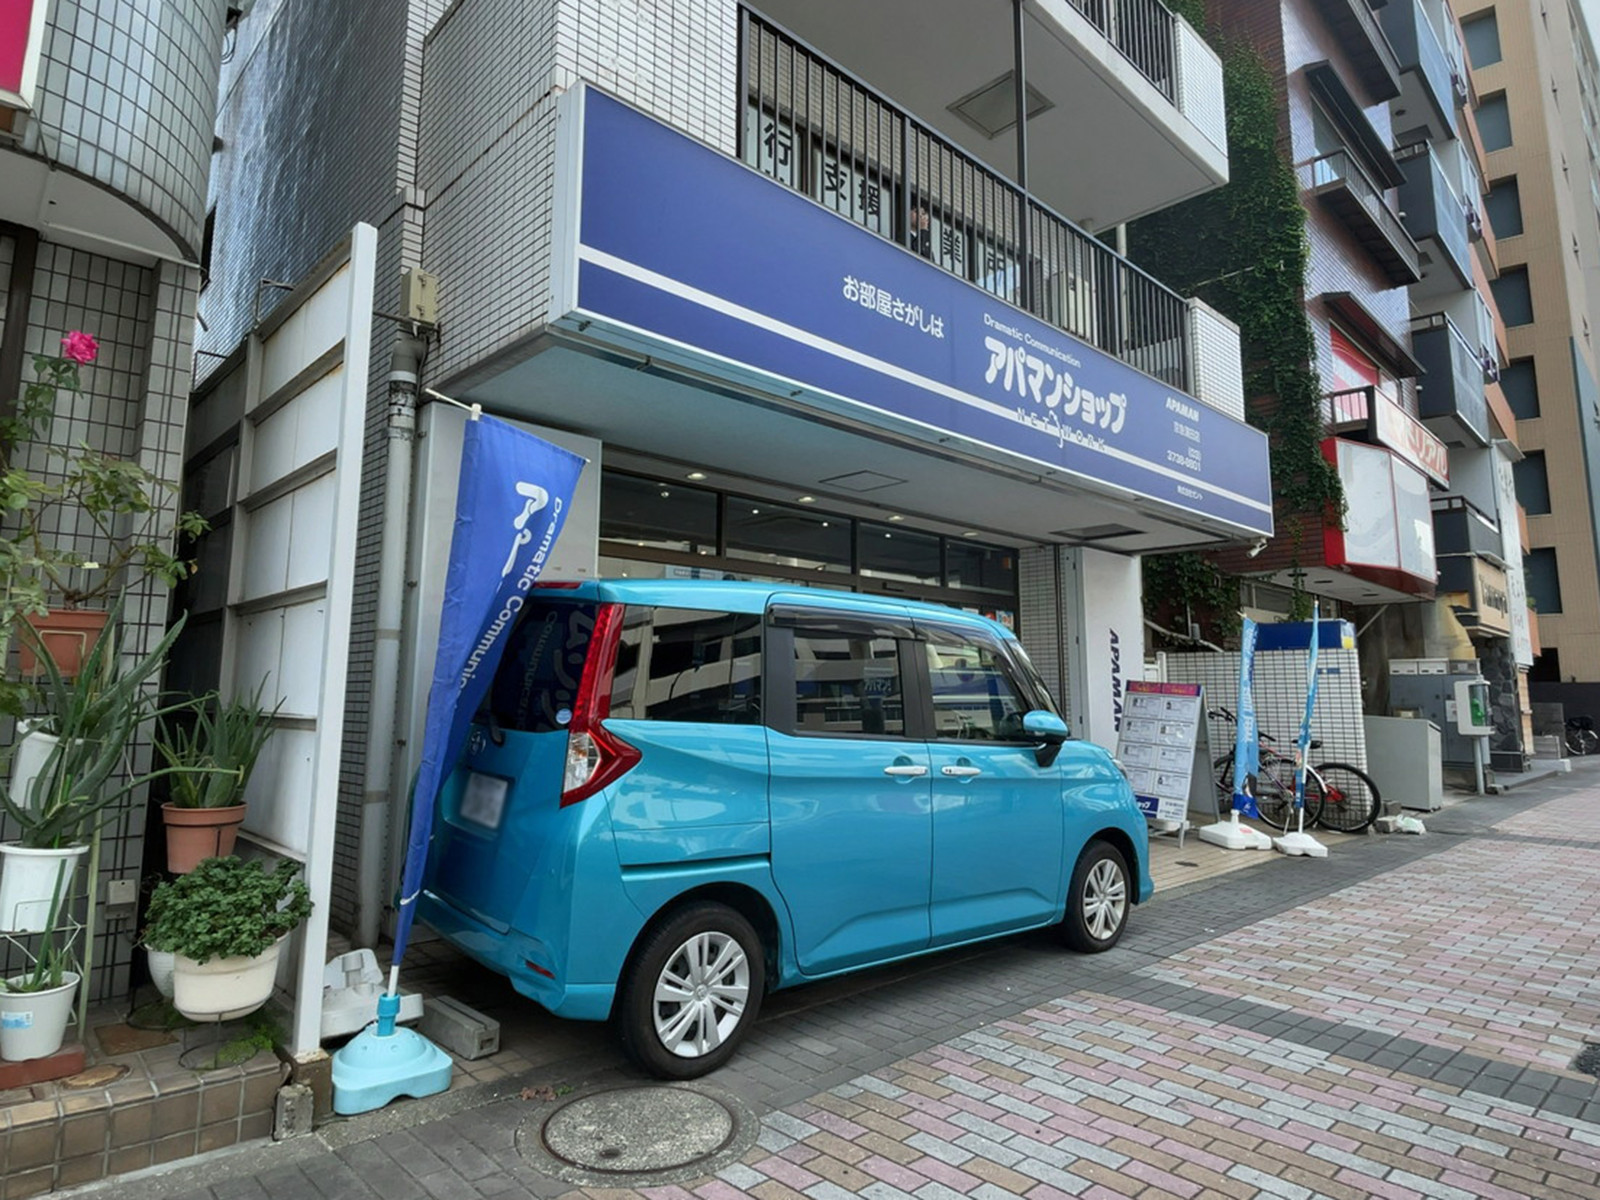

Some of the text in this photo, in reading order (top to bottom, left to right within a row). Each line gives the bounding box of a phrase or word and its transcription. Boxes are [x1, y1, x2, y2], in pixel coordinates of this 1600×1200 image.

[843, 275, 944, 338] お部屋さがしは
[983, 313, 1081, 368] Dramatic Communication
[984, 336, 1127, 434] アパマンショップ
[1165, 396, 1200, 422] APAMAN
[517, 497, 563, 591] Dramatic
[1109, 628, 1123, 733] APAMAN
